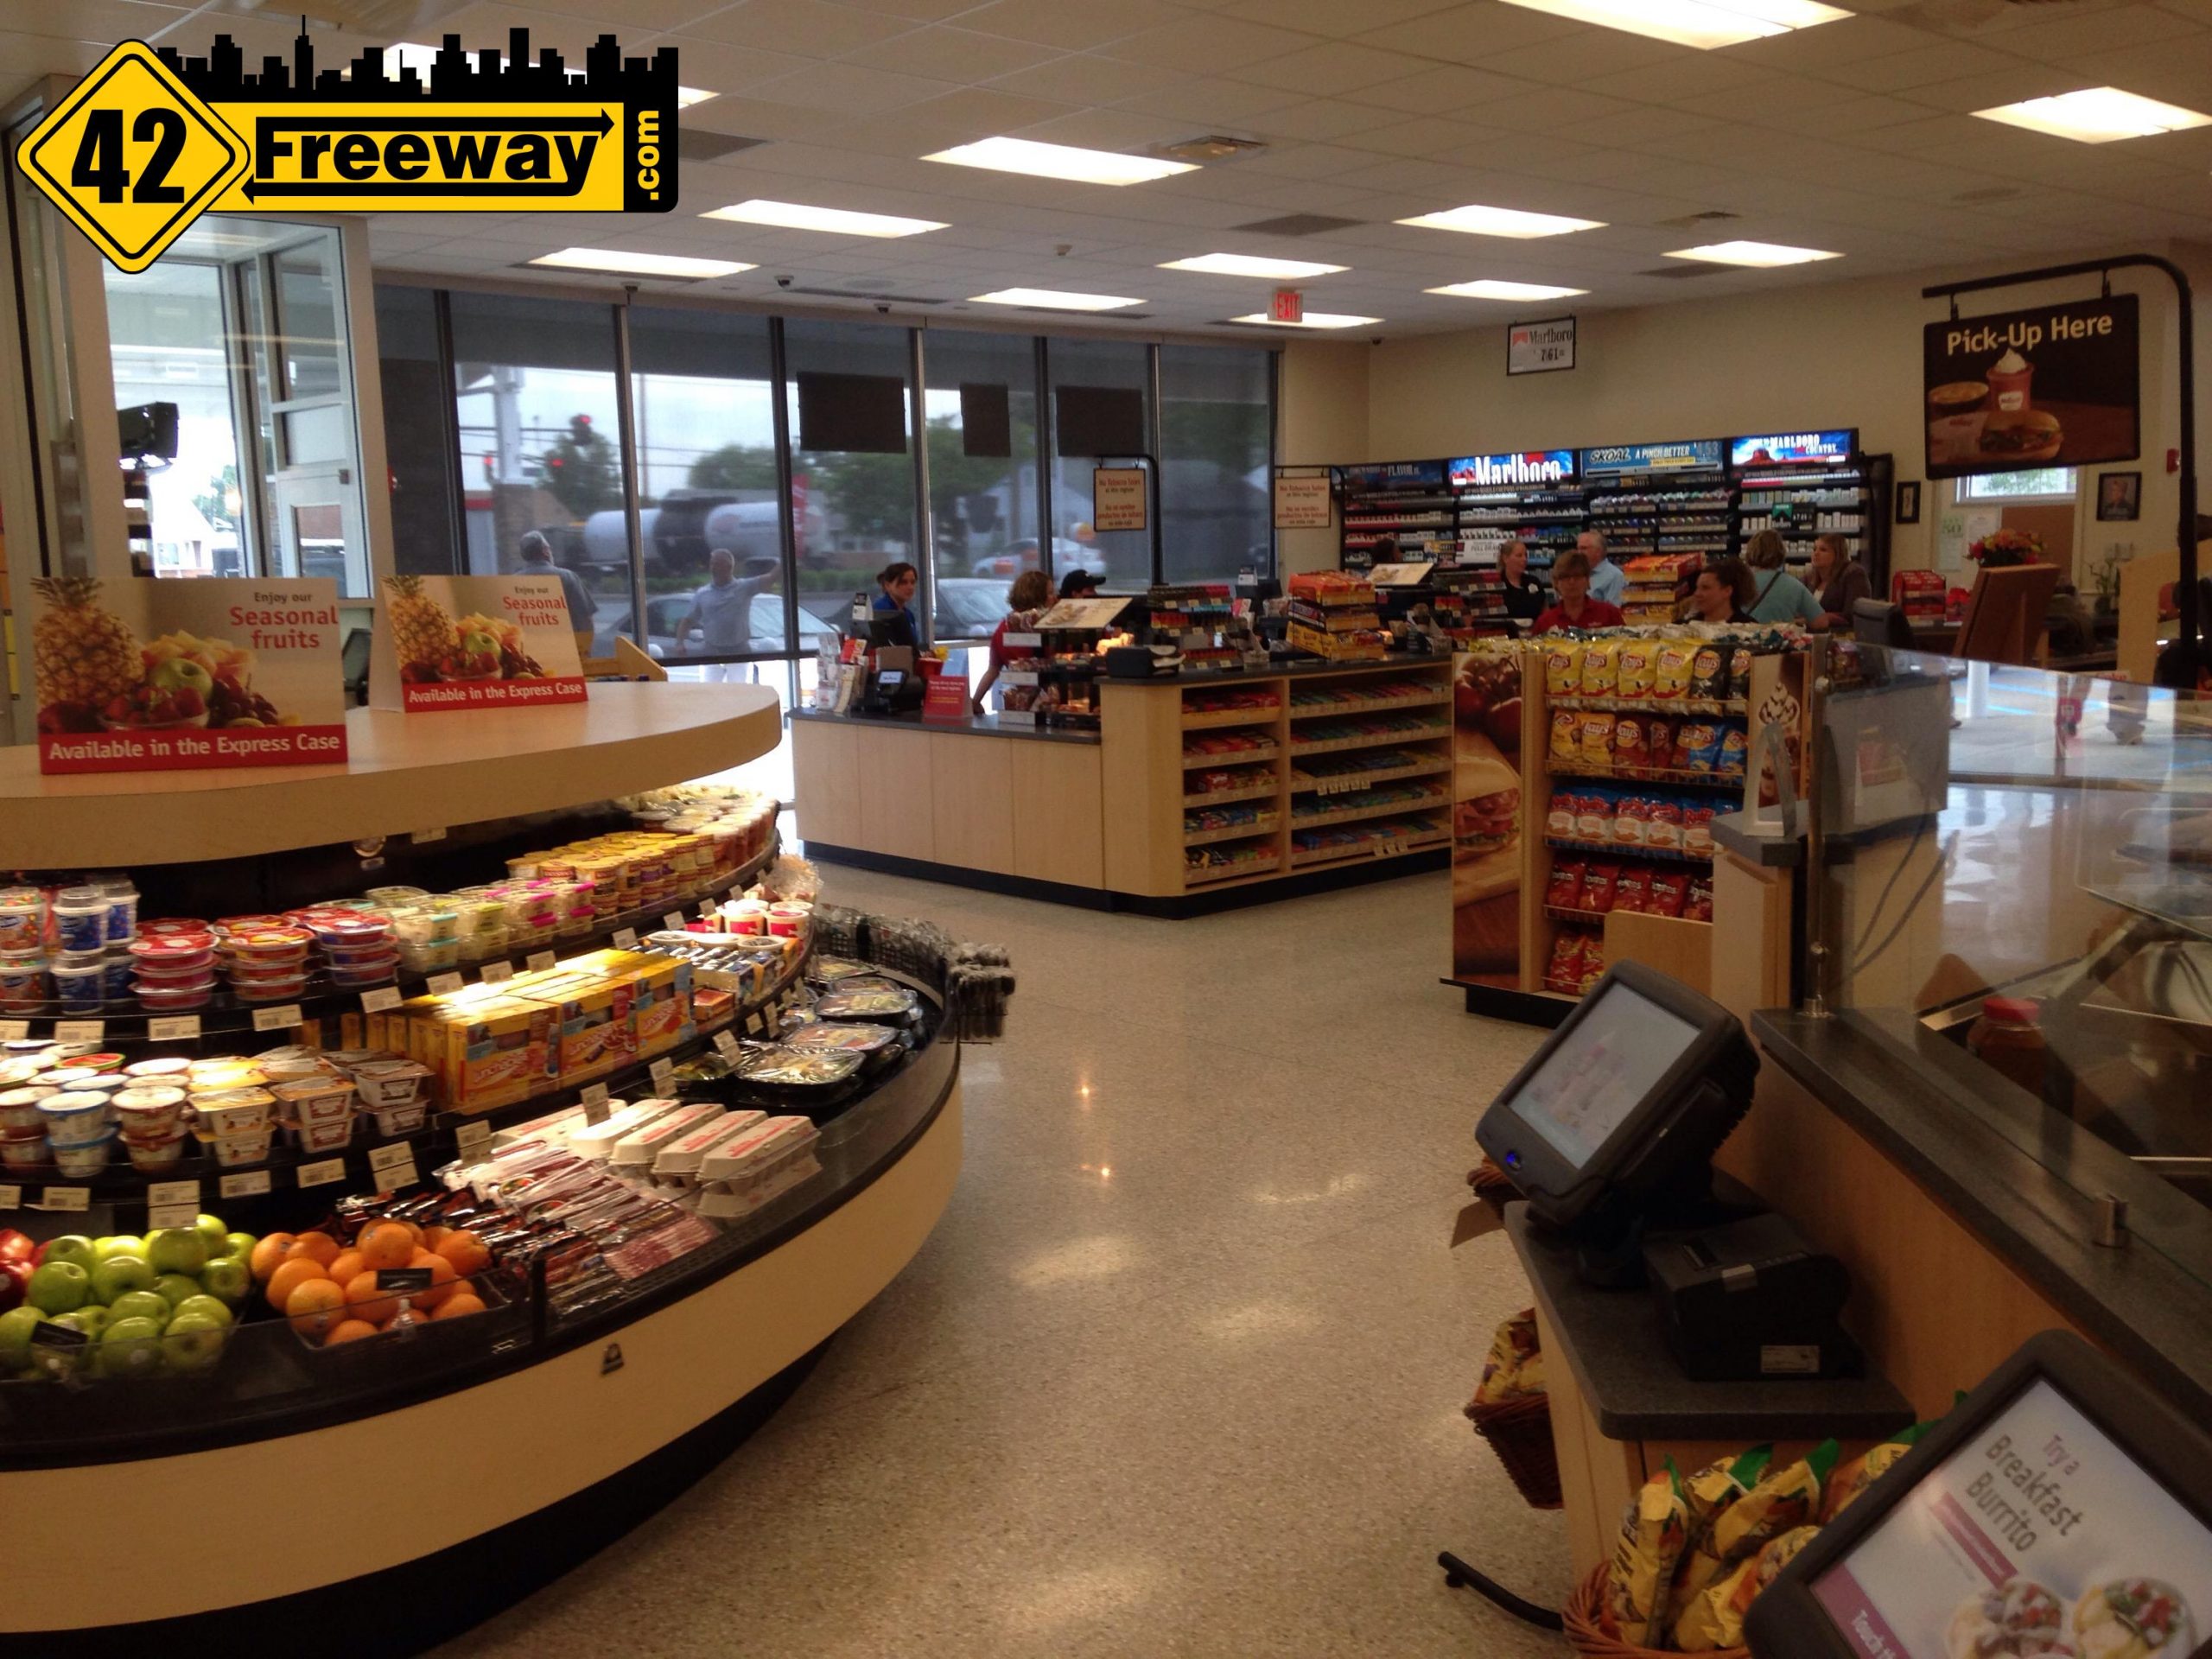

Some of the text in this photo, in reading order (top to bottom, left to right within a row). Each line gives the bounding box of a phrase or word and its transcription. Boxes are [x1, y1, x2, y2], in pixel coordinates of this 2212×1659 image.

[1277, 293, 1300, 319] EXIT
[1529, 327, 1573, 344] Marlboro
[1947, 315, 2113, 356] Pick-Up Here
[1589, 448, 1631, 464] SKOAL
[1475, 453, 1561, 486] Marlboro
[254, 592, 312, 604] Enjoy our
[515, 586, 536, 596] Enjoy
[503, 596, 567, 610] Seasonal
[230, 606, 339, 626] Seasonal
[518, 612, 559, 626] fruits
[251, 629, 320, 649] fruits
[409, 683, 582, 703] Available in the Express Case
[49, 733, 340, 760] Available in the Express Case
[2043, 1433, 2080, 1476] Try a
[1985, 1433, 2083, 1536] Breakfast
[1966, 1470, 2037, 1552] Burrito
